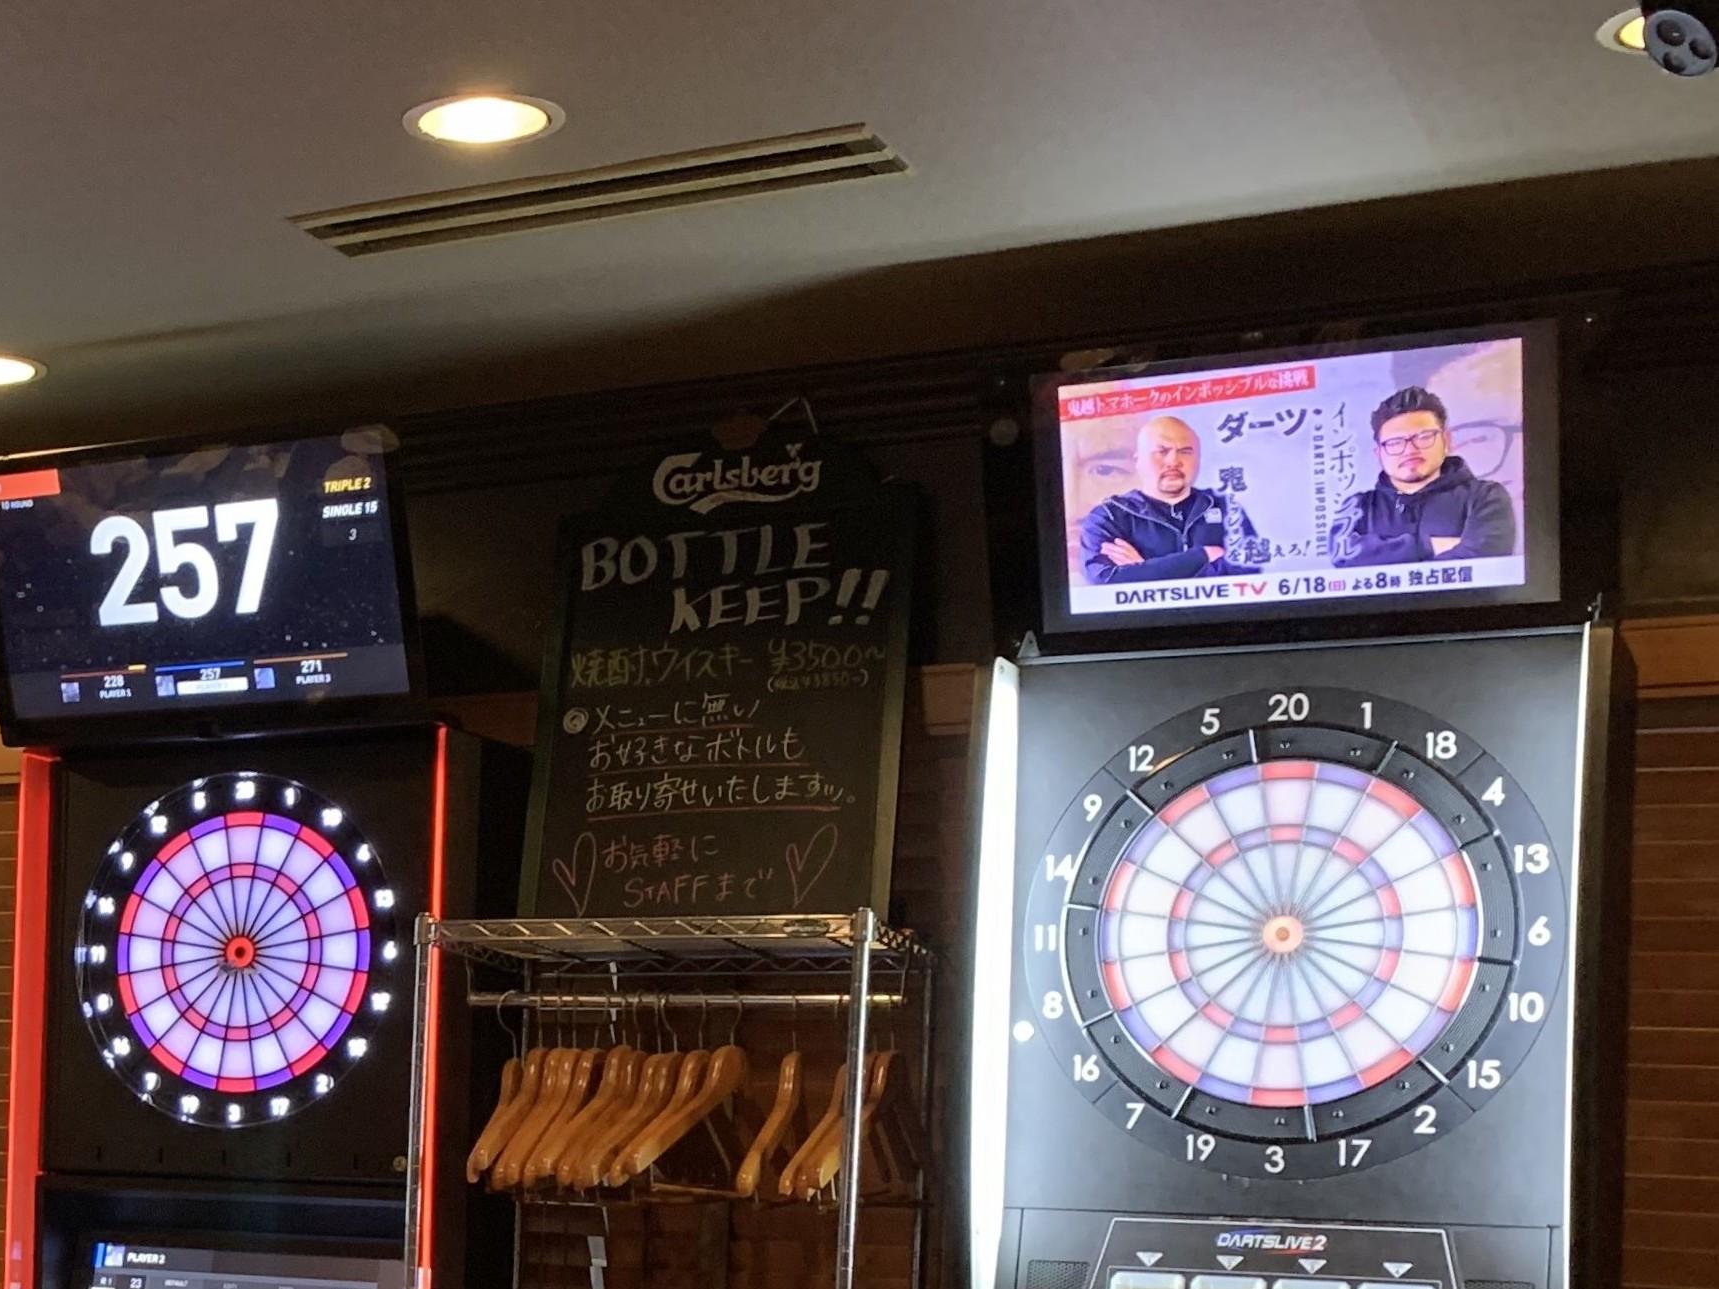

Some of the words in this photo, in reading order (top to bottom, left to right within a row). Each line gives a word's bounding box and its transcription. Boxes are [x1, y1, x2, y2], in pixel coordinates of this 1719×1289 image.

[323, 478, 362, 493] TRIPLE
[363, 477, 372, 490] 2
[652, 443, 822, 514] Carlsberg
[323, 504, 363, 519] SINGLE
[364, 501, 379, 515] 15
[90, 498, 279, 626] 257
[581, 523, 831, 591] BOTTLE
[669, 567, 890, 634] KEEP!!
[1115, 584, 1230, 606] DARTSLIVE
[1232, 581, 1267, 597] TV
[300, 660, 323, 673] 271
[1201, 708, 1222, 735] 5
[1267, 693, 1310, 723] 20
[1361, 703, 1373, 730] 1
[588, 726, 805, 771] お好きなボトルも
[1128, 745, 1155, 773] 12
[1425, 732, 1458, 760] 18
[1481, 777, 1505, 806] 4
[1083, 794, 1103, 822] 9
[602, 834, 720, 873] お気軽に
[1513, 844, 1550, 875] 13
[1045, 855, 1074, 882] 14
[1033, 924, 1057, 951] 11
[1528, 916, 1552, 946] 6
[1042, 991, 1064, 1020] 8
[1509, 992, 1545, 1022] 10
[1072, 1054, 1100, 1082] 16
[1466, 1060, 1502, 1088] 15
[1126, 1102, 1147, 1130] 7
[1414, 1106, 1437, 1135] 2
[1185, 1134, 1217, 1161] 19
[1264, 1146, 1286, 1174] 3
[1337, 1138, 1372, 1168] 17
[1215, 1232, 1328, 1251] DARTSLIVE2
[126, 1252, 158, 1264] PLAYER
